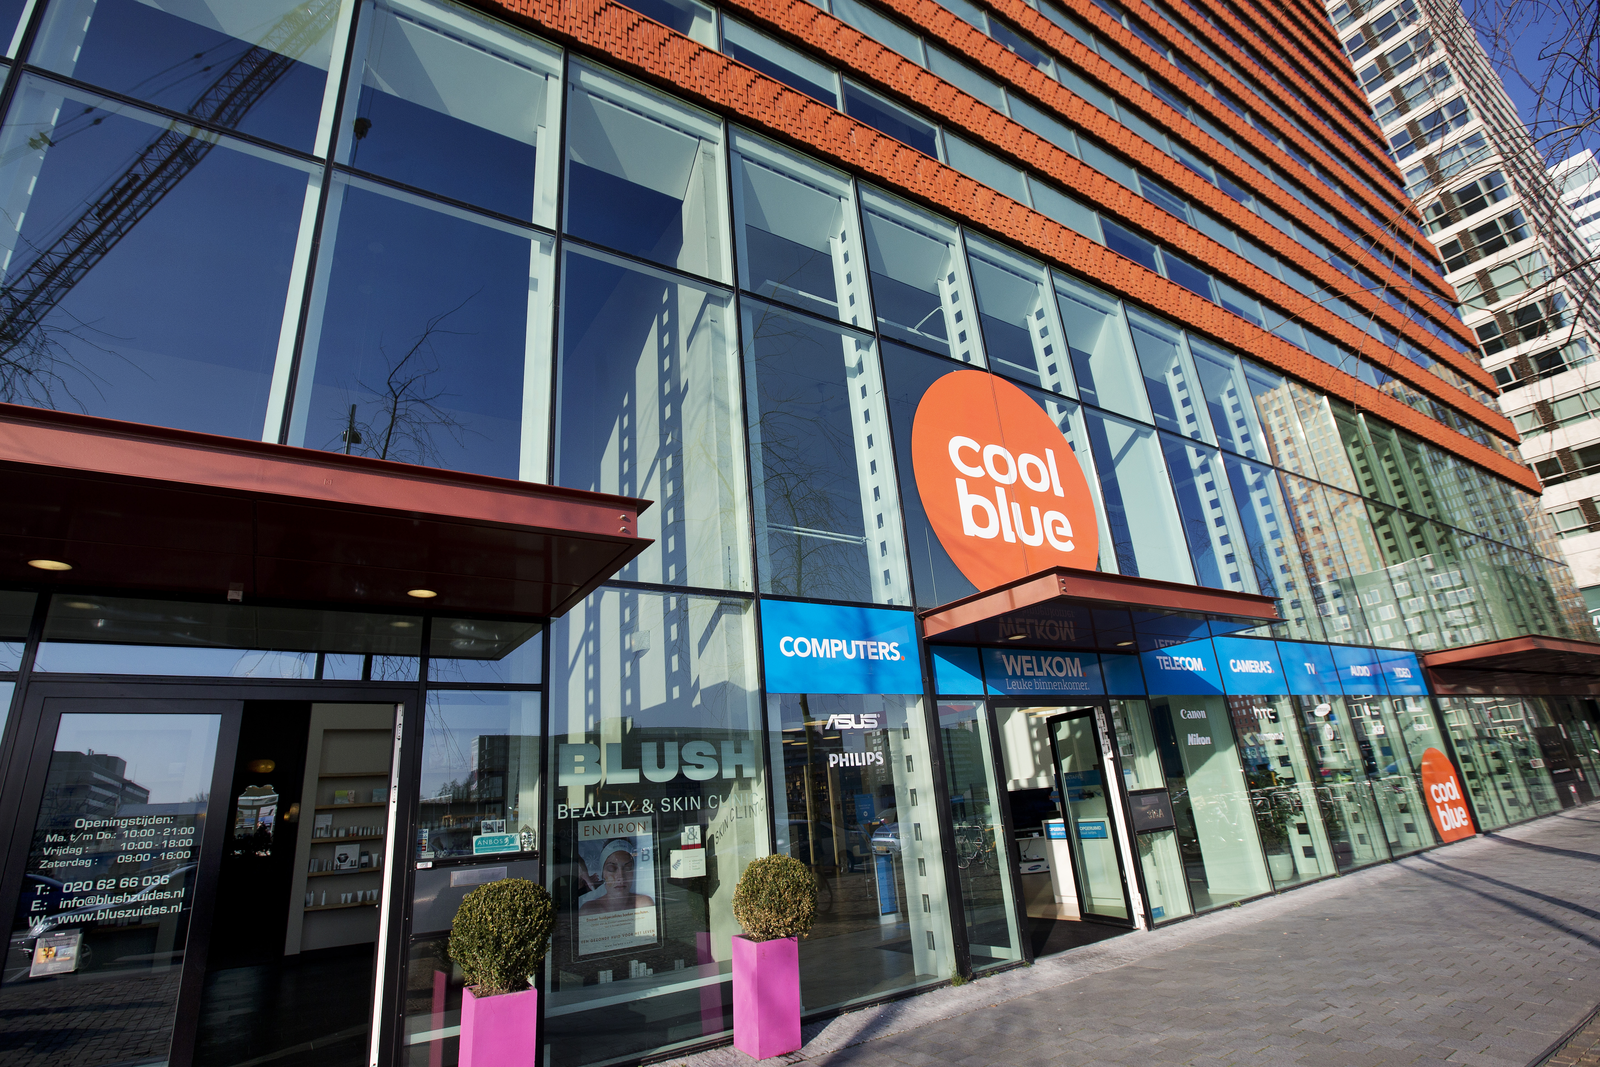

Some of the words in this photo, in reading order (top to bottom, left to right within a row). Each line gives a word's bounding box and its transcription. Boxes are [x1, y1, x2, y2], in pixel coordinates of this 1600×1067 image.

[948, 435, 1065, 498] cool
[955, 477, 1075, 552] blue
[780, 636, 906, 661] COMPUTERS.
[1002, 654, 1086, 677] WELKOM.
[1156, 656, 1206, 671] TELECOM.
[1005, 678, 1033, 690] Leuke
[1034, 679, 1090, 690] binnenkomer.
[824, 713, 879, 730] ASUS
[1180, 708, 1206, 719] Canon
[1188, 733, 1212, 746] Nikon
[559, 739, 756, 787] BLUSH
[829, 752, 884, 768] PHILIPS
[1430, 776, 1460, 803] cool
[558, 800, 634, 820] BEAUTY
[642, 798, 654, 814] &
[661, 796, 701, 812] SKIN
[708, 792, 758, 808] CLINIC
[74, 816, 174, 830] Openingstijden:
[1436, 803, 1469, 831] blue
[45, 834, 67, 842] Ma.
[70, 832, 93, 843] t/m
[123, 829, 155, 838] 10:00
[163, 827, 194, 835] 21:00
[584, 821, 646, 837] ENVIRON
[43, 846, 83, 856] Vrijdag
[120, 841, 152, 850] 10:00
[162, 839, 193, 848] 18:00
[39, 858, 92, 869] Zaterdag
[117, 854, 150, 863] 09:00
[160, 851, 191, 860] 16:00
[62, 881, 93, 893] 020
[96, 879, 116, 890] 62
[120, 877, 139, 888] 66
[142, 875, 170, 886] 036
[59, 888, 185, 909] info@blushzuidas.nl
[57, 902, 182, 924] www.bluszuidas.nl
